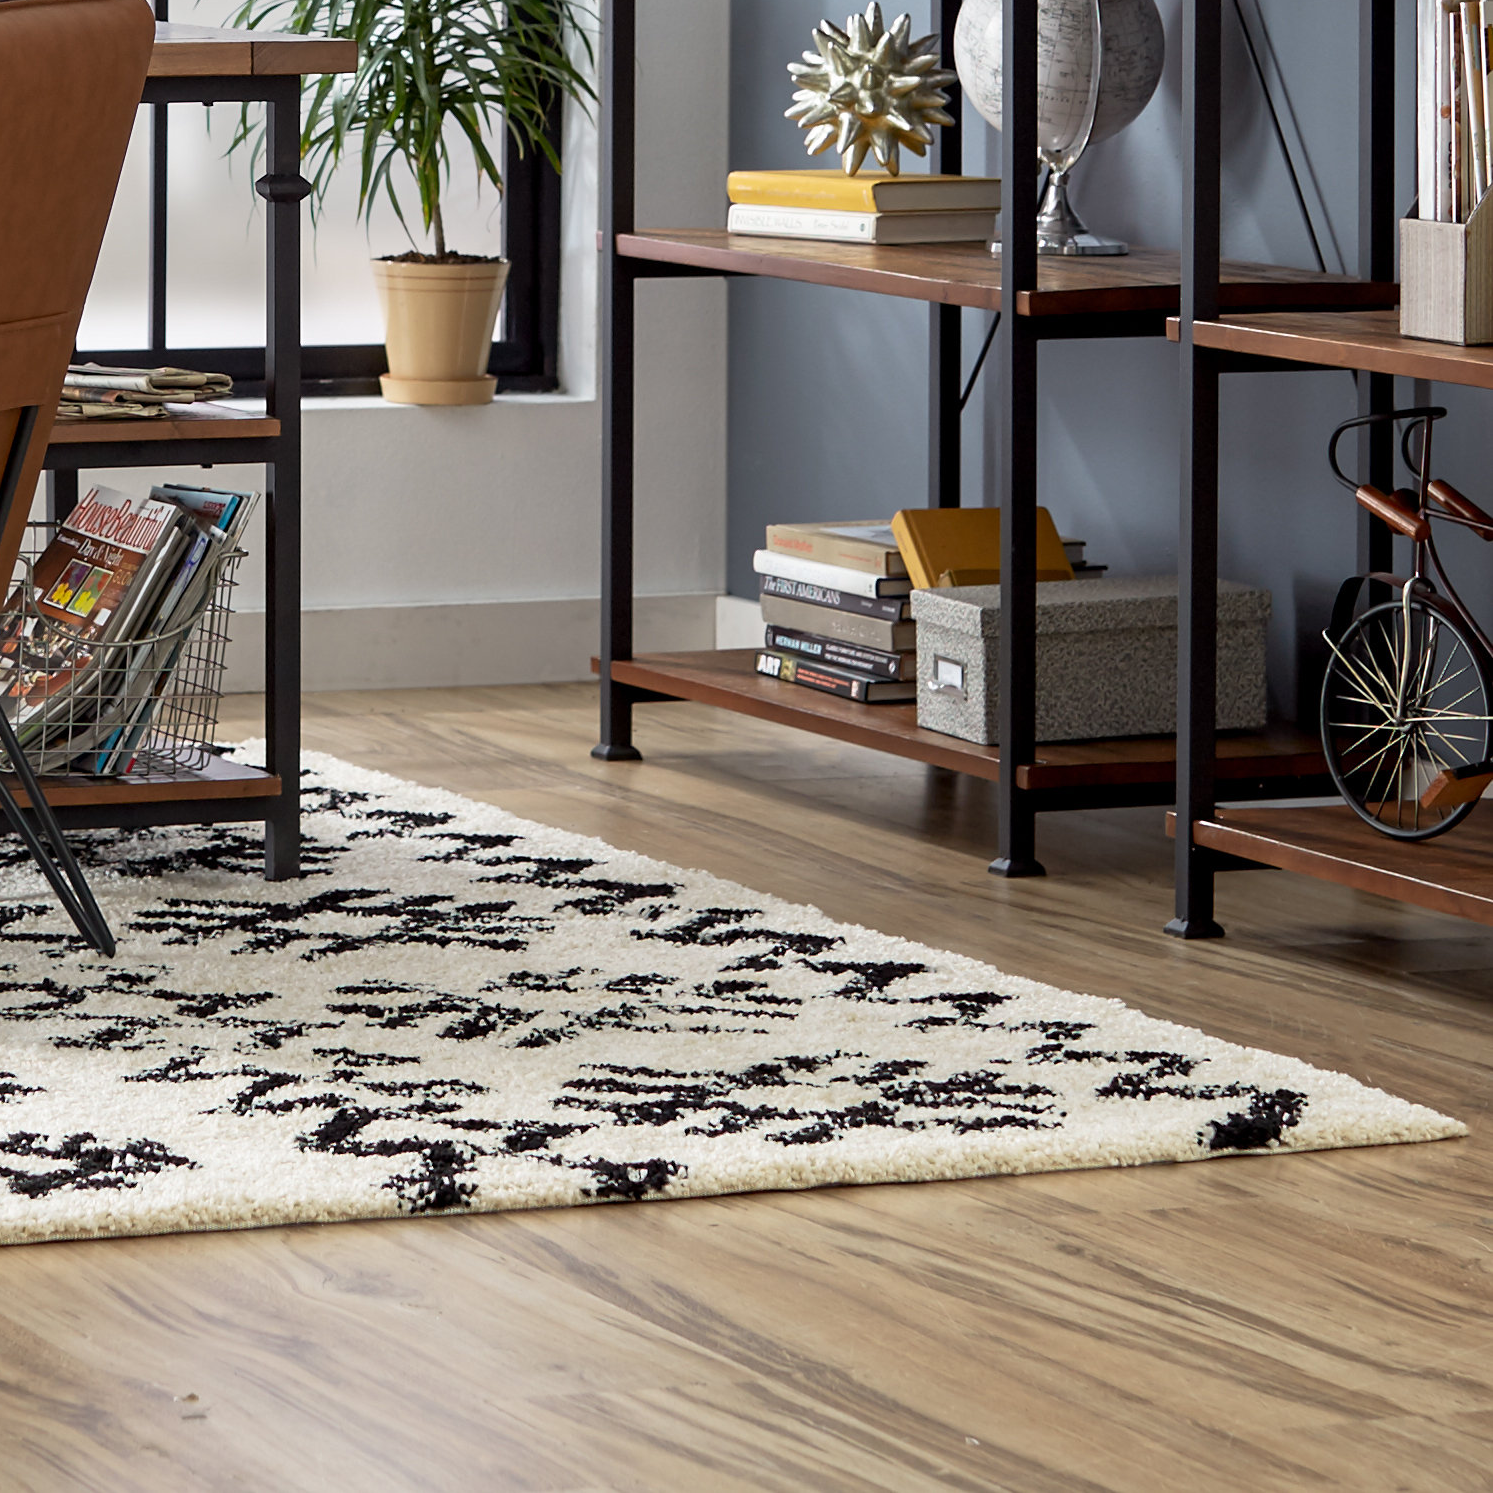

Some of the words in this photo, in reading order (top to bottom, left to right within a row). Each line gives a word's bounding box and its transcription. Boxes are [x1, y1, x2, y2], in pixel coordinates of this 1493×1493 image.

[776, 578, 797, 596] FIRST
[796, 583, 841, 605] AMERICANS
[800, 640, 823, 656] MILLER
[756, 654, 782, 676] ART
